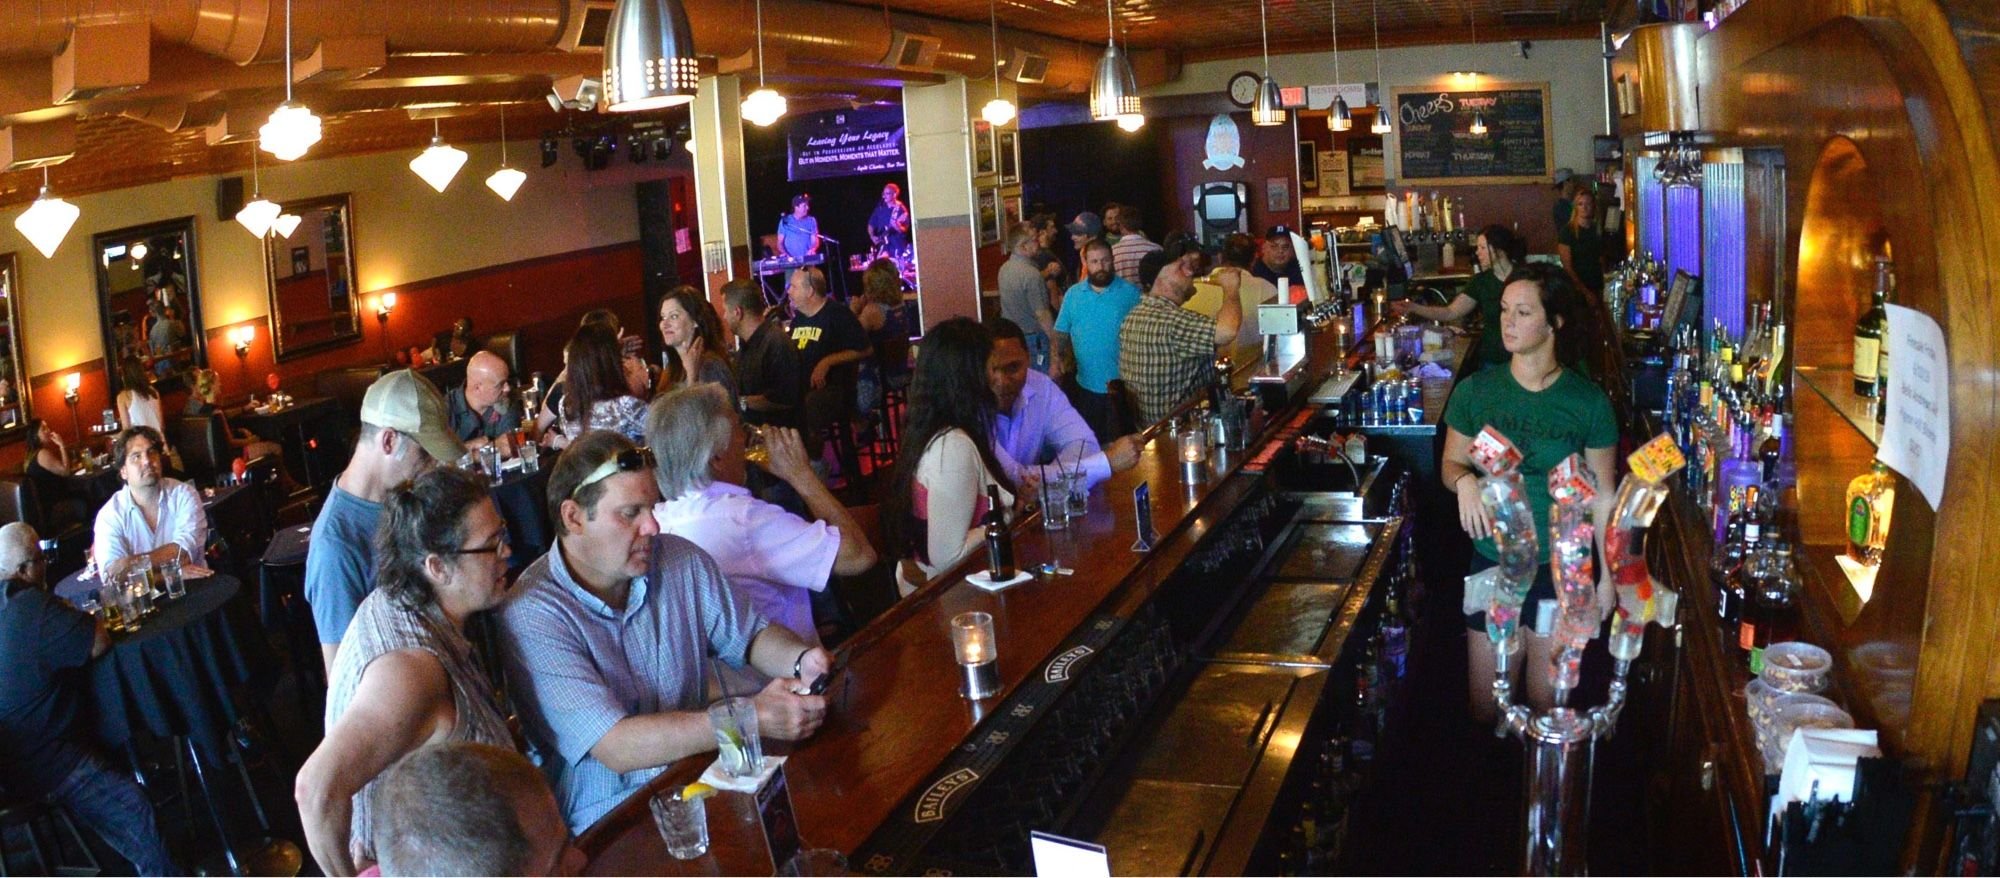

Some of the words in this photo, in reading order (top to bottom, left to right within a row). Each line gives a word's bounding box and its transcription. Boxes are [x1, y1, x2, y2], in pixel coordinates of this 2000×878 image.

[1311, 85, 1363, 95] RESTROOMS
[807, 136, 836, 147] Leaving
[839, 132, 860, 146] Your
[863, 131, 889, 142] Legacy
[1051, 648, 1086, 681] BAILEYS
[920, 772, 970, 818] BAILEYS
